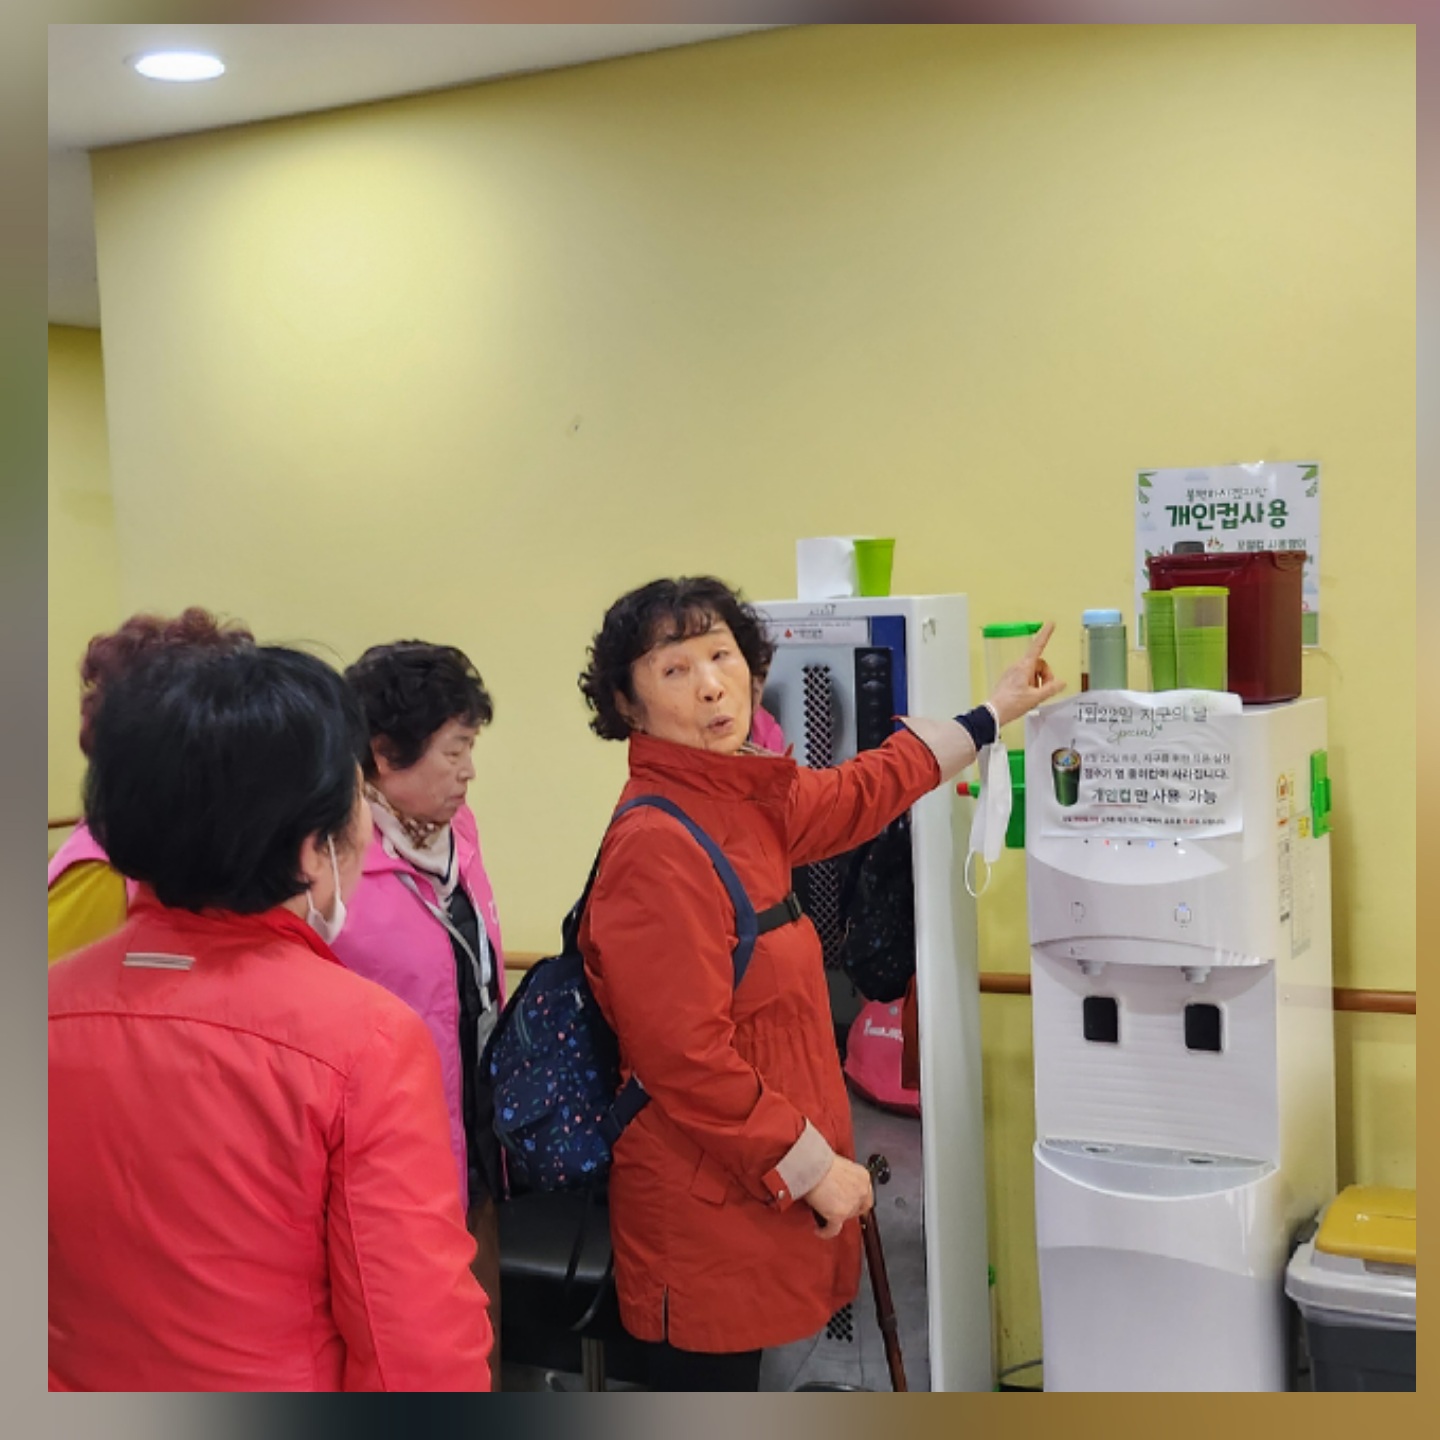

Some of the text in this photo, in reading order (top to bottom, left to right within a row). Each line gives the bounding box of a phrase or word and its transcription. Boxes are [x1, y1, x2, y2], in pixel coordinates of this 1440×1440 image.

[1165, 498, 1289, 531] 개인컵사용
[1140, 706, 1188, 723] 지구의
[1193, 706, 1208, 723] 날
[1092, 789, 1132, 804] 개인컵
